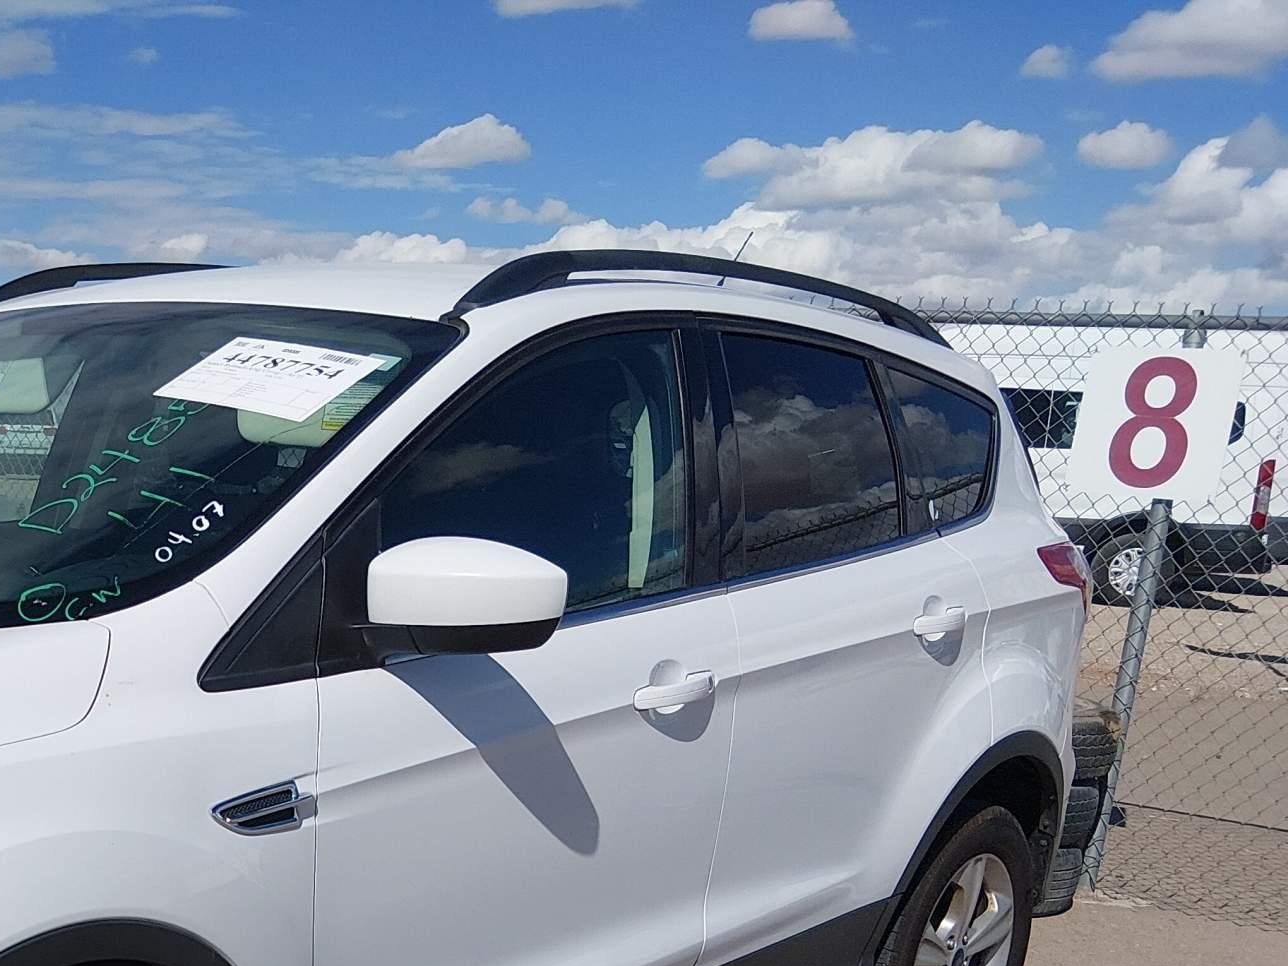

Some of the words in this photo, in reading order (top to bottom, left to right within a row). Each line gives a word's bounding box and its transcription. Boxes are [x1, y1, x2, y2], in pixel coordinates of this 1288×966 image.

[223, 352, 345, 380] 44787754
[1108, 356, 1198, 488] 8
[154, 500, 225, 563] 04.07
